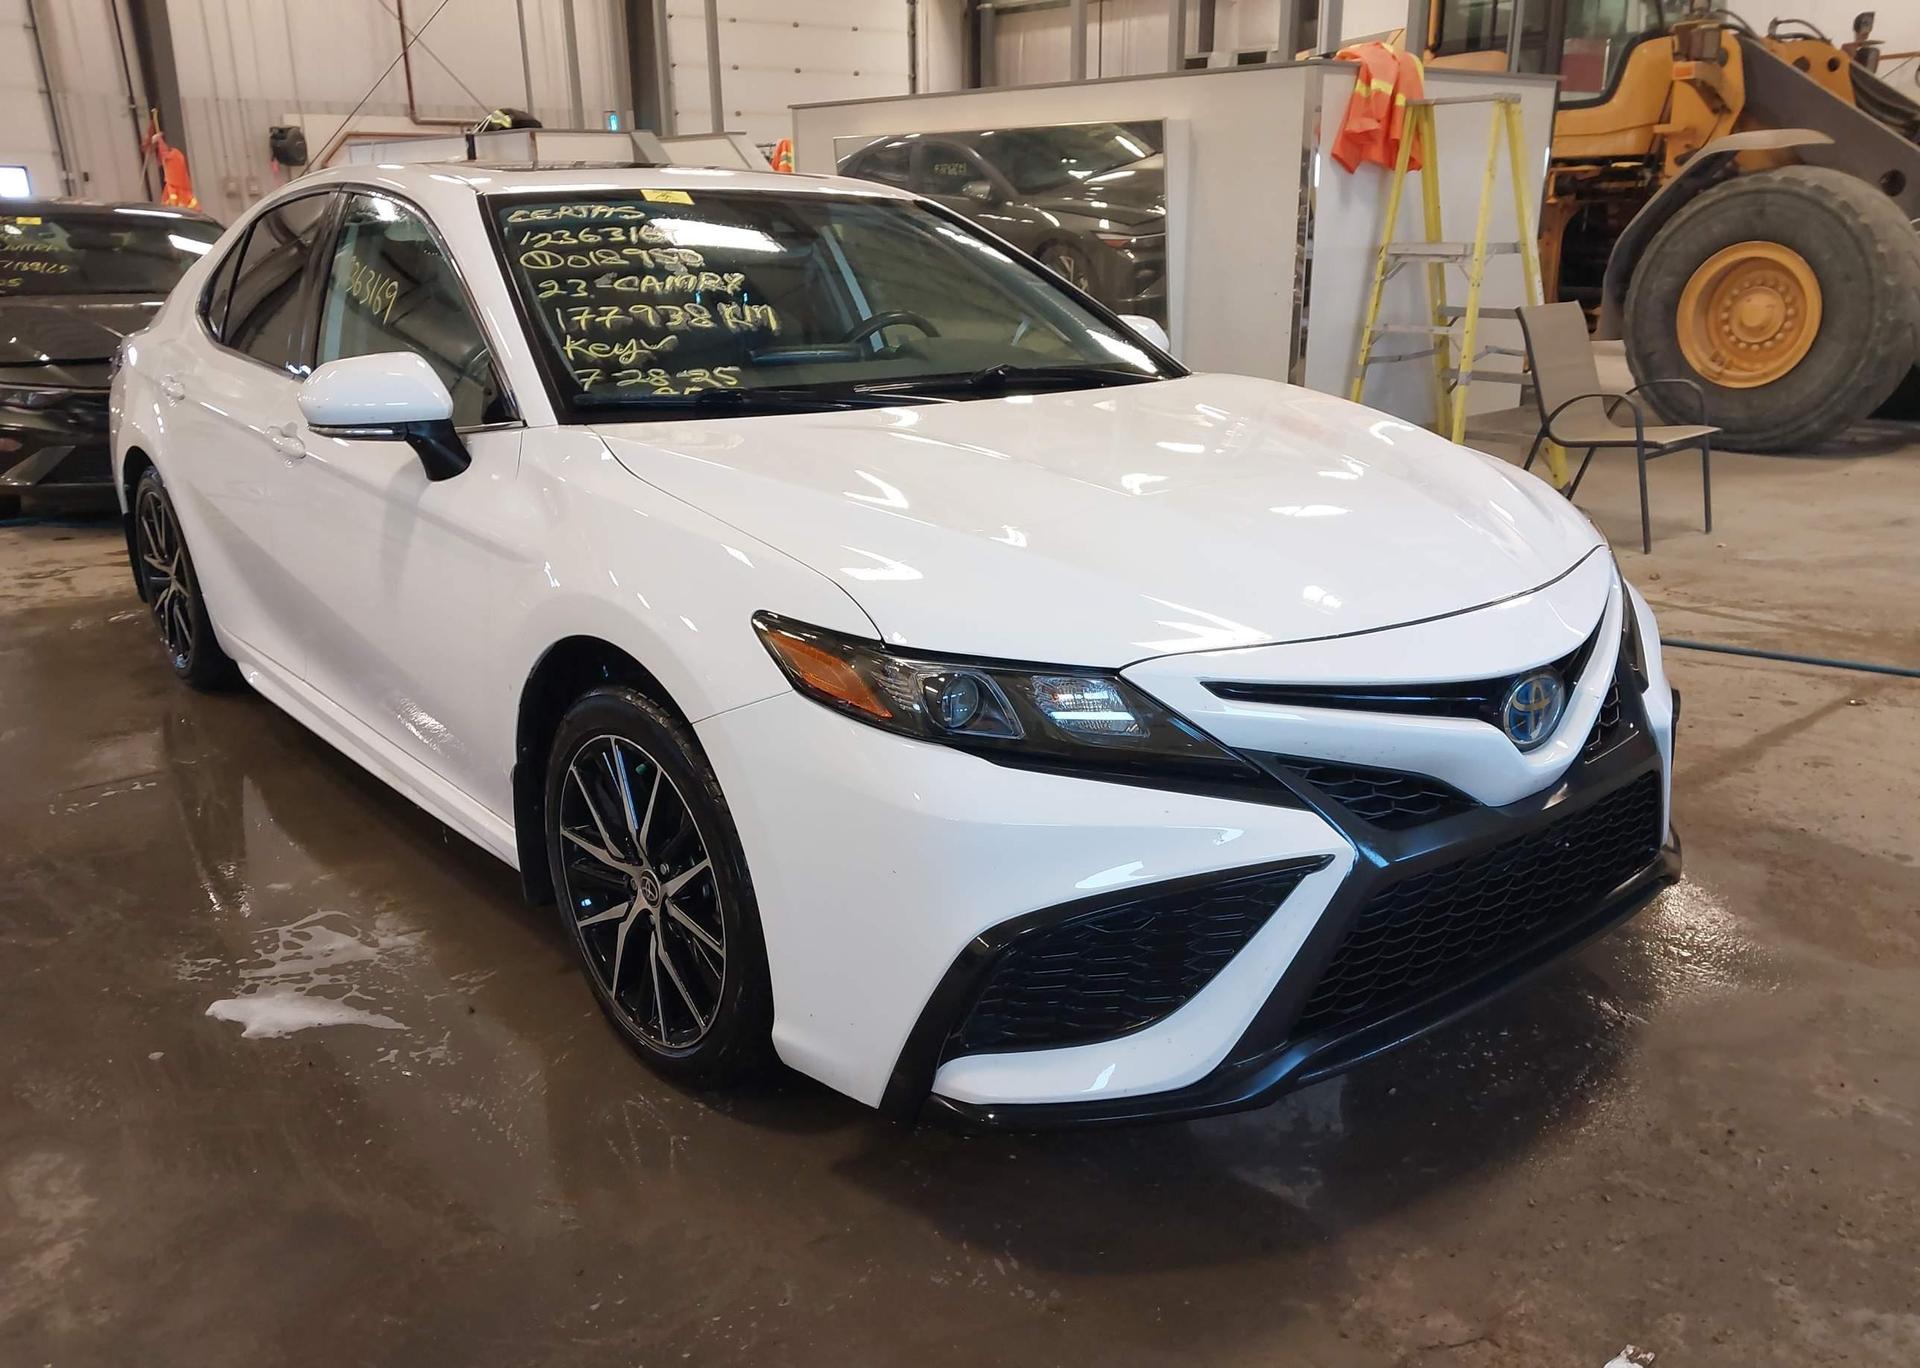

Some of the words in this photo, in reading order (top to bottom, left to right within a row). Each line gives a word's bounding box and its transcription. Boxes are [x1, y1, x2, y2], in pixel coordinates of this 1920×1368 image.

[613, 272, 746, 296] CAMRY
[555, 303, 716, 331] 177938
[717, 301, 781, 336] KM
